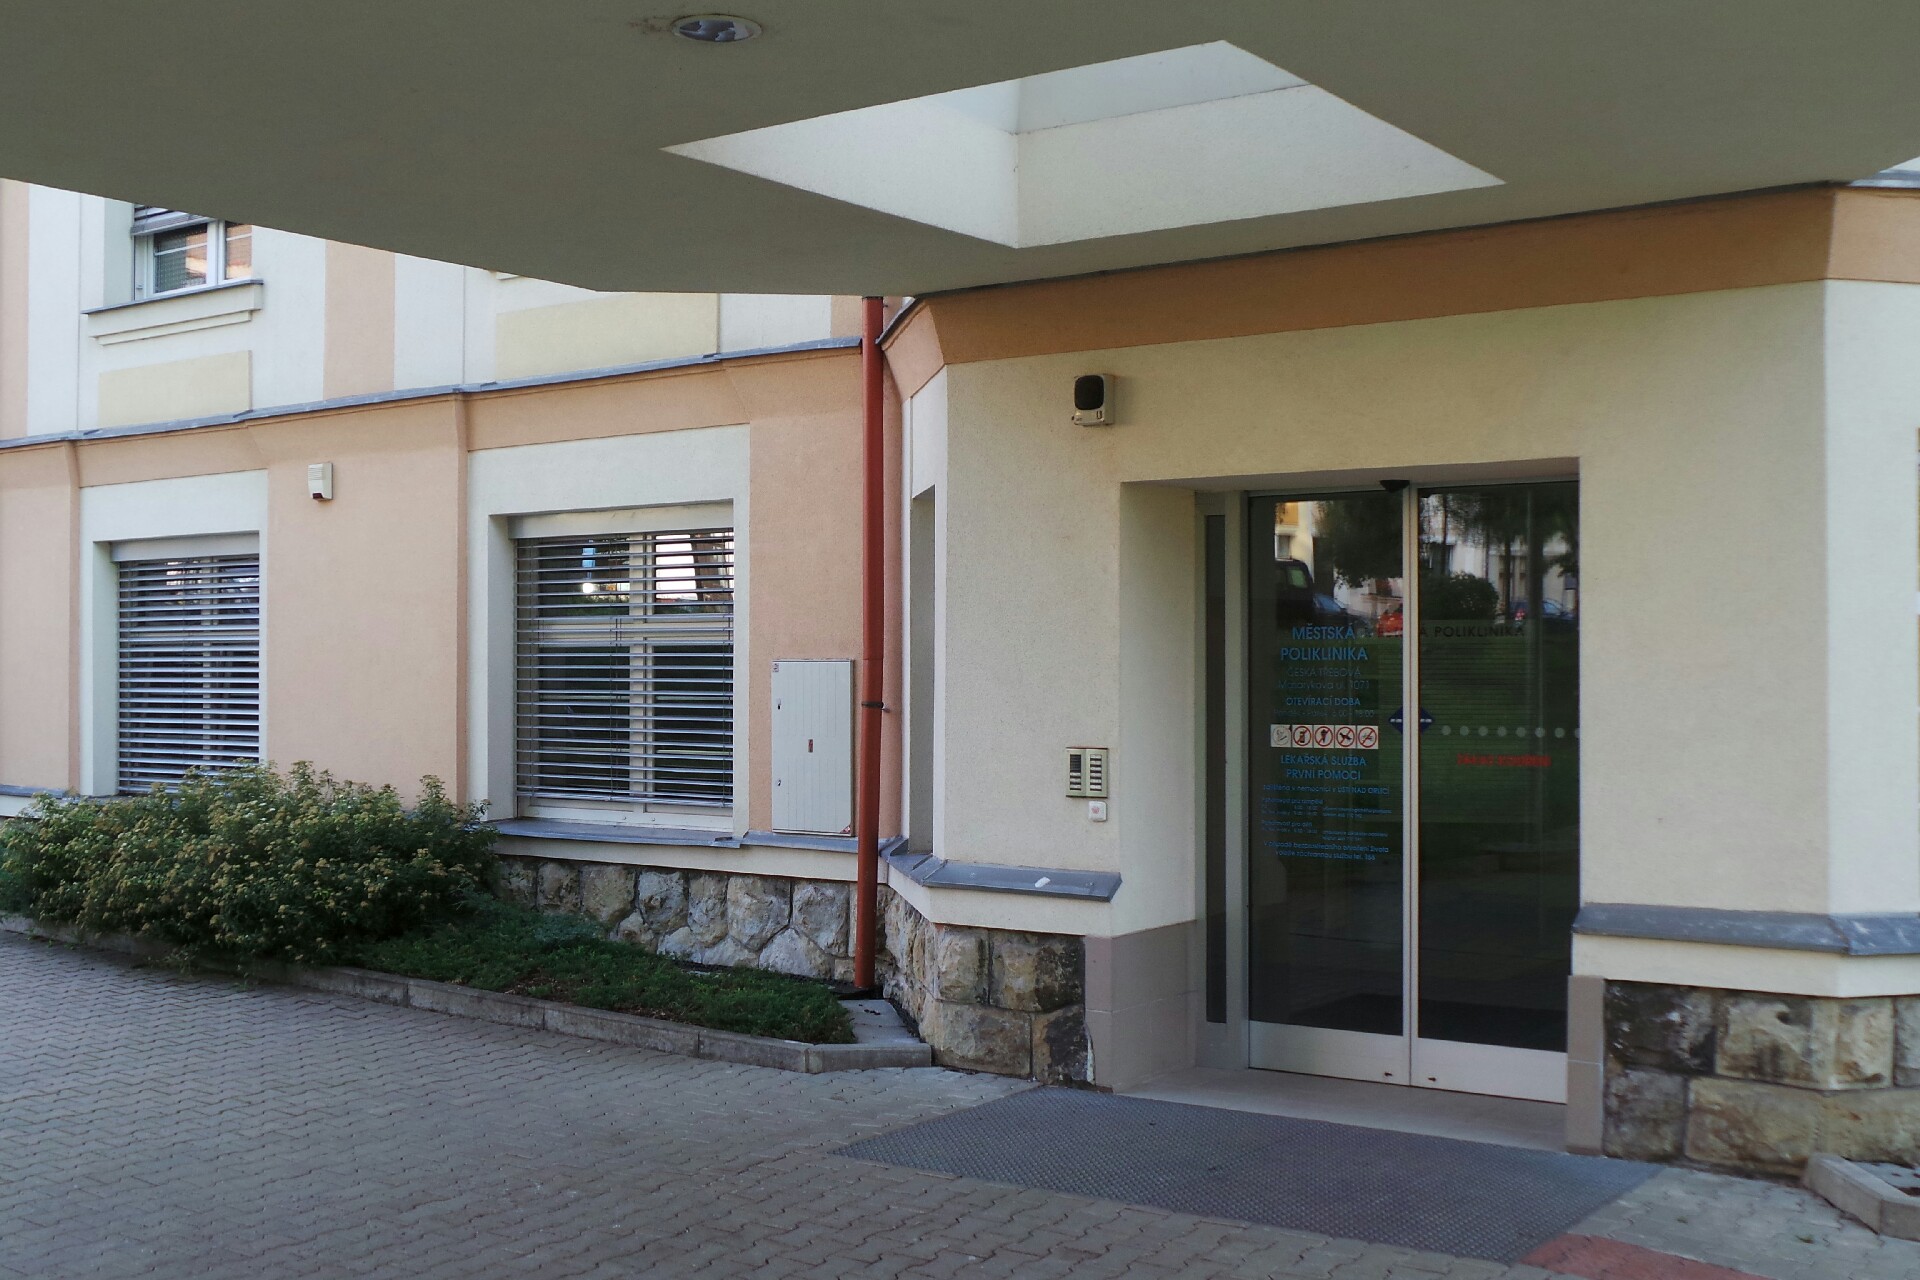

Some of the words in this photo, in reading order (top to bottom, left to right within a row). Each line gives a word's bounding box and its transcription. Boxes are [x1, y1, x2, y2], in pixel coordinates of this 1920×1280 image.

[1292, 623, 1356, 640] MĚSTSKÁ
[1434, 626, 1525, 638] POLIKLINIKA
[1280, 647, 1368, 660] POLIKLINIKA
[1286, 695, 1332, 706] OTEVÍRACÍ
[1334, 697, 1361, 706] DOBA
[1280, 754, 1328, 765] LÉKAŘSKÁ
[1331, 755, 1366, 766] SLUŽBA
[1286, 767, 1315, 779] PRVNÍ
